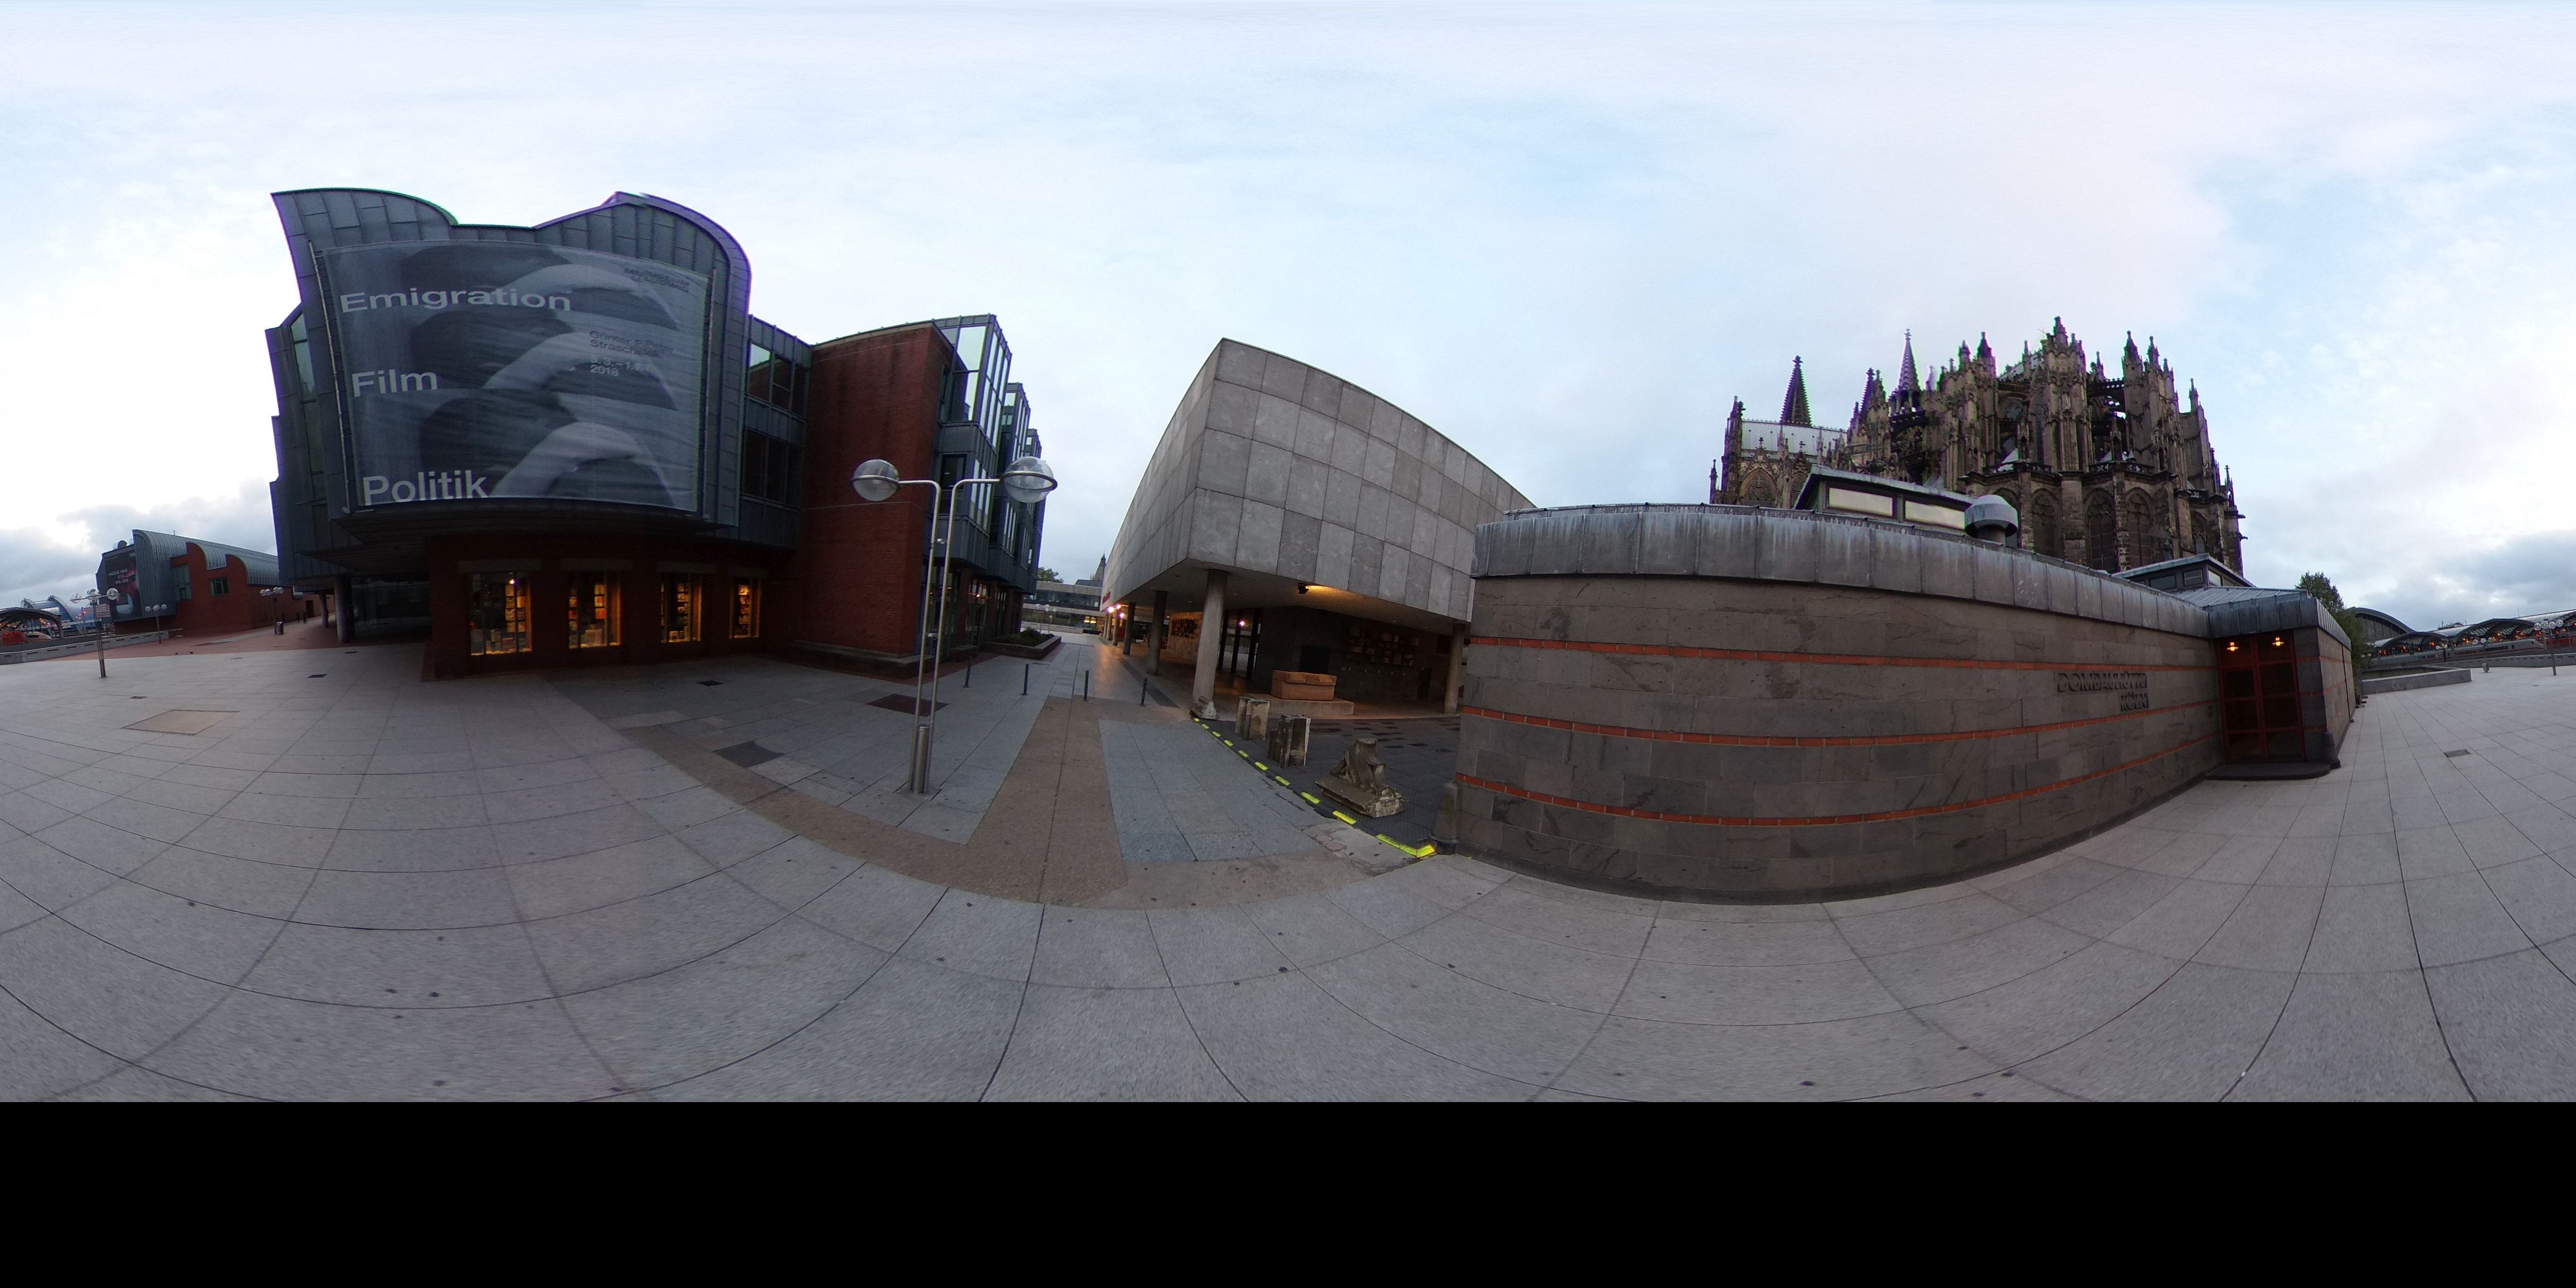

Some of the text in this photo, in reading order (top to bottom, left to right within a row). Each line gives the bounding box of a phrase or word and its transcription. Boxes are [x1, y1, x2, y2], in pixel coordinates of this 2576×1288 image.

[340, 288, 571, 313] Emigration
[352, 369, 437, 397] Film
[590, 364, 619, 377] 2018
[363, 470, 489, 506] Politik
